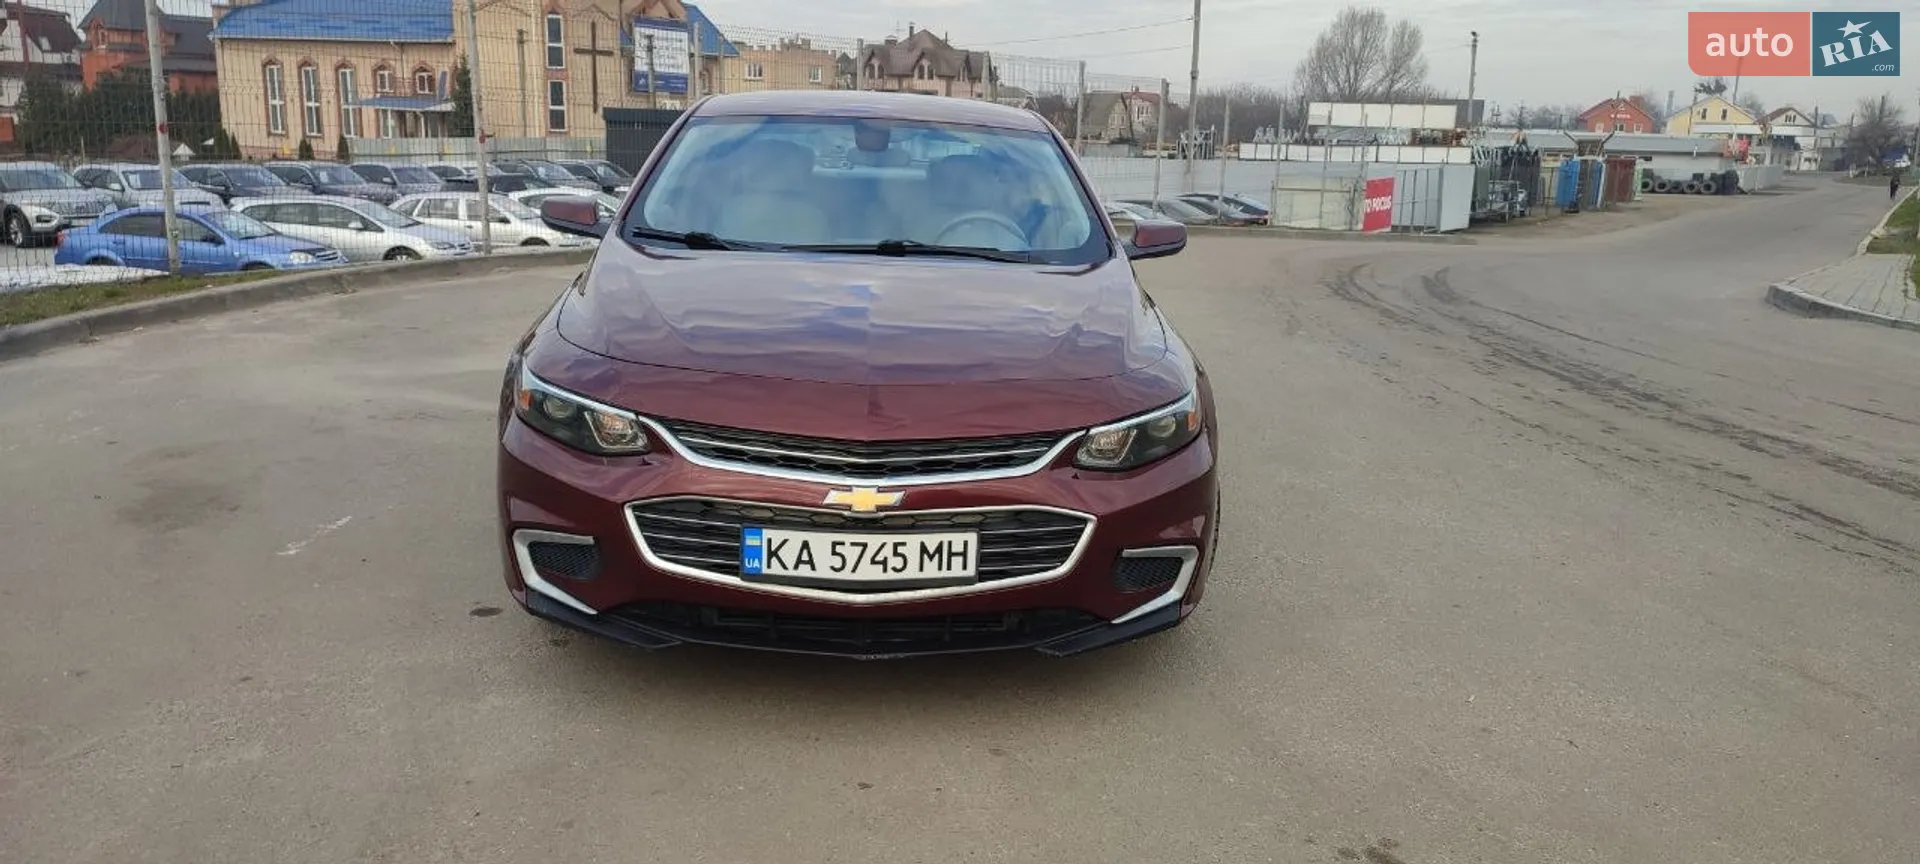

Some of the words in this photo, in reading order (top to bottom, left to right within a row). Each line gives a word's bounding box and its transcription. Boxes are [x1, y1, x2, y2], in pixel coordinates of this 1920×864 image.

[745, 558, 760, 568] UA
[766, 537, 817, 572] KA
[829, 541, 908, 573] 5745
[918, 540, 969, 572] MH
